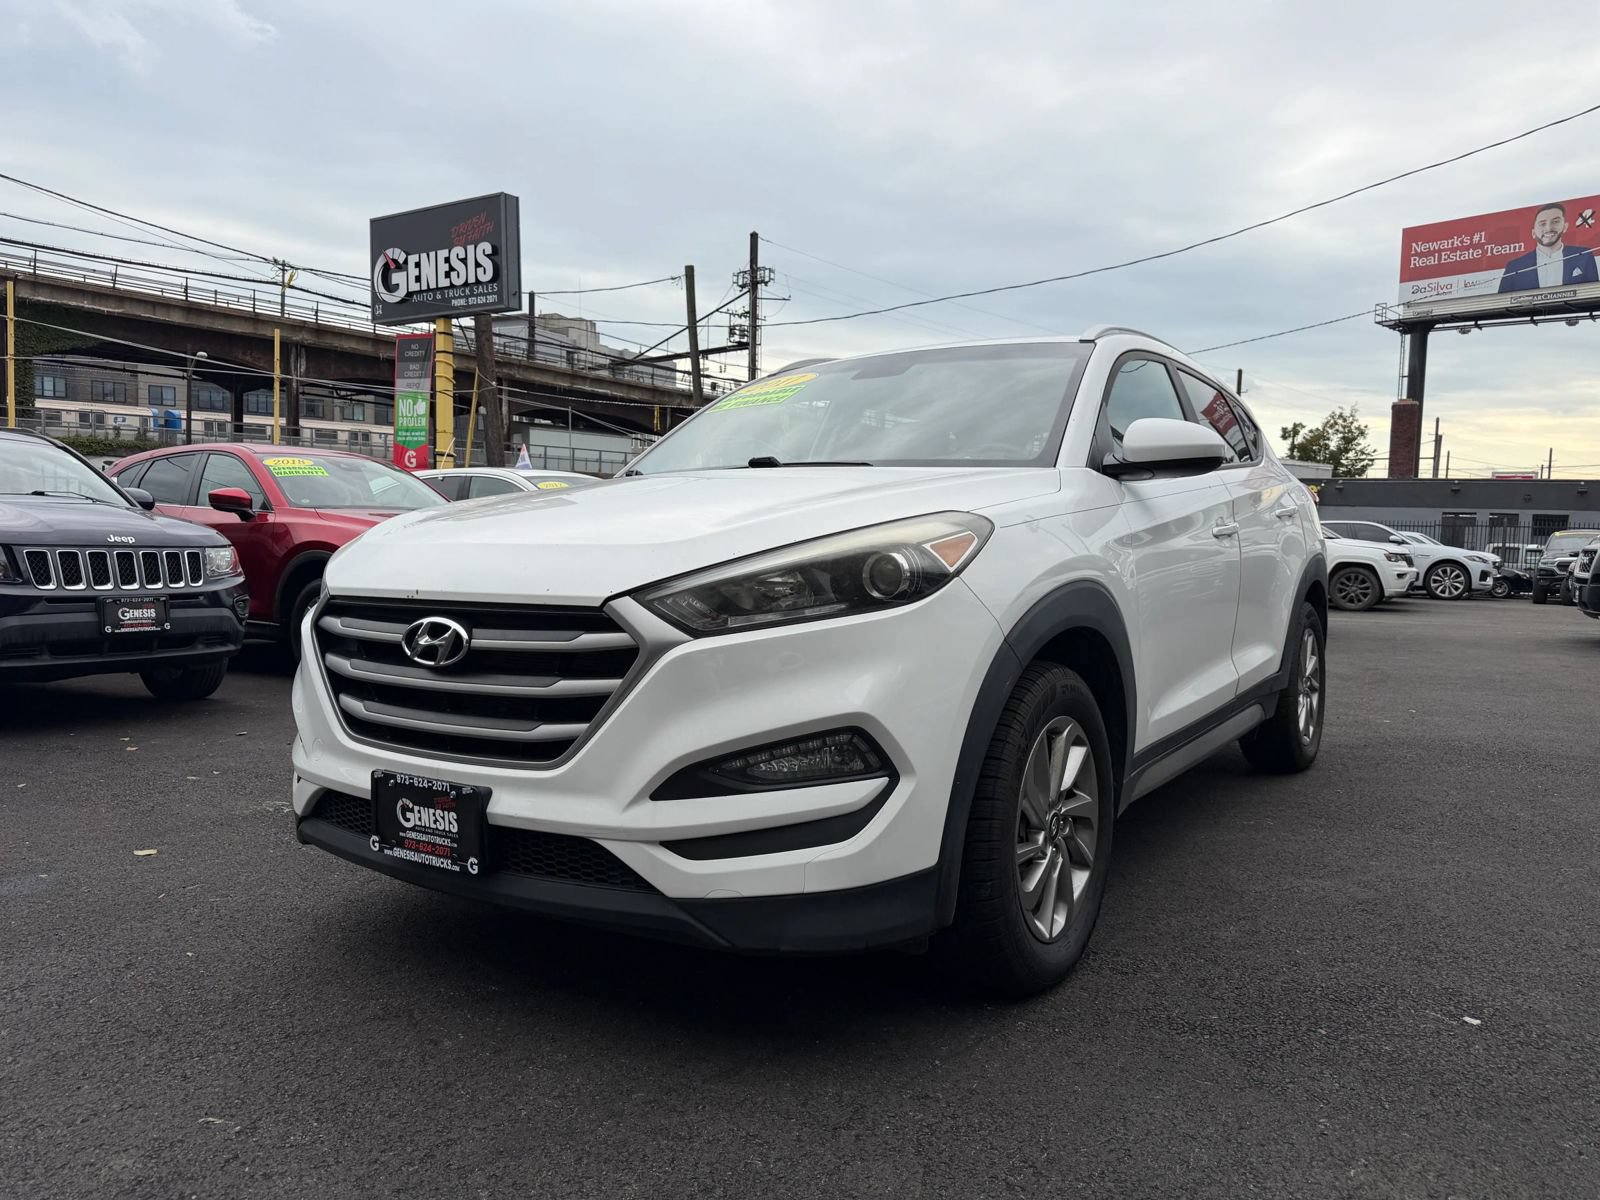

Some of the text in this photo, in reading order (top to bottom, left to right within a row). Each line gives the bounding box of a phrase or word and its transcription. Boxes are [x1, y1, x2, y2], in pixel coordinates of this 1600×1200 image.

[1411, 231, 1486, 254] Newark's #1
[1410, 242, 1525, 268] Real Estate Team
[373, 241, 494, 304] GENESIS
[412, 282, 498, 303] AUTO & TRUCK SALES
[1411, 281, 1453, 295] DaSilva
[399, 399, 413, 417] NO
[106, 534, 136, 544] Jeep
[118, 607, 156, 620] GENESIS
[396, 774, 450, 793] 973-624-2071
[396, 798, 459, 833] GENESIS
[370, 835, 379, 851] G
[404, 839, 451, 857] 973-624-2071
[467, 857, 479, 875] G
